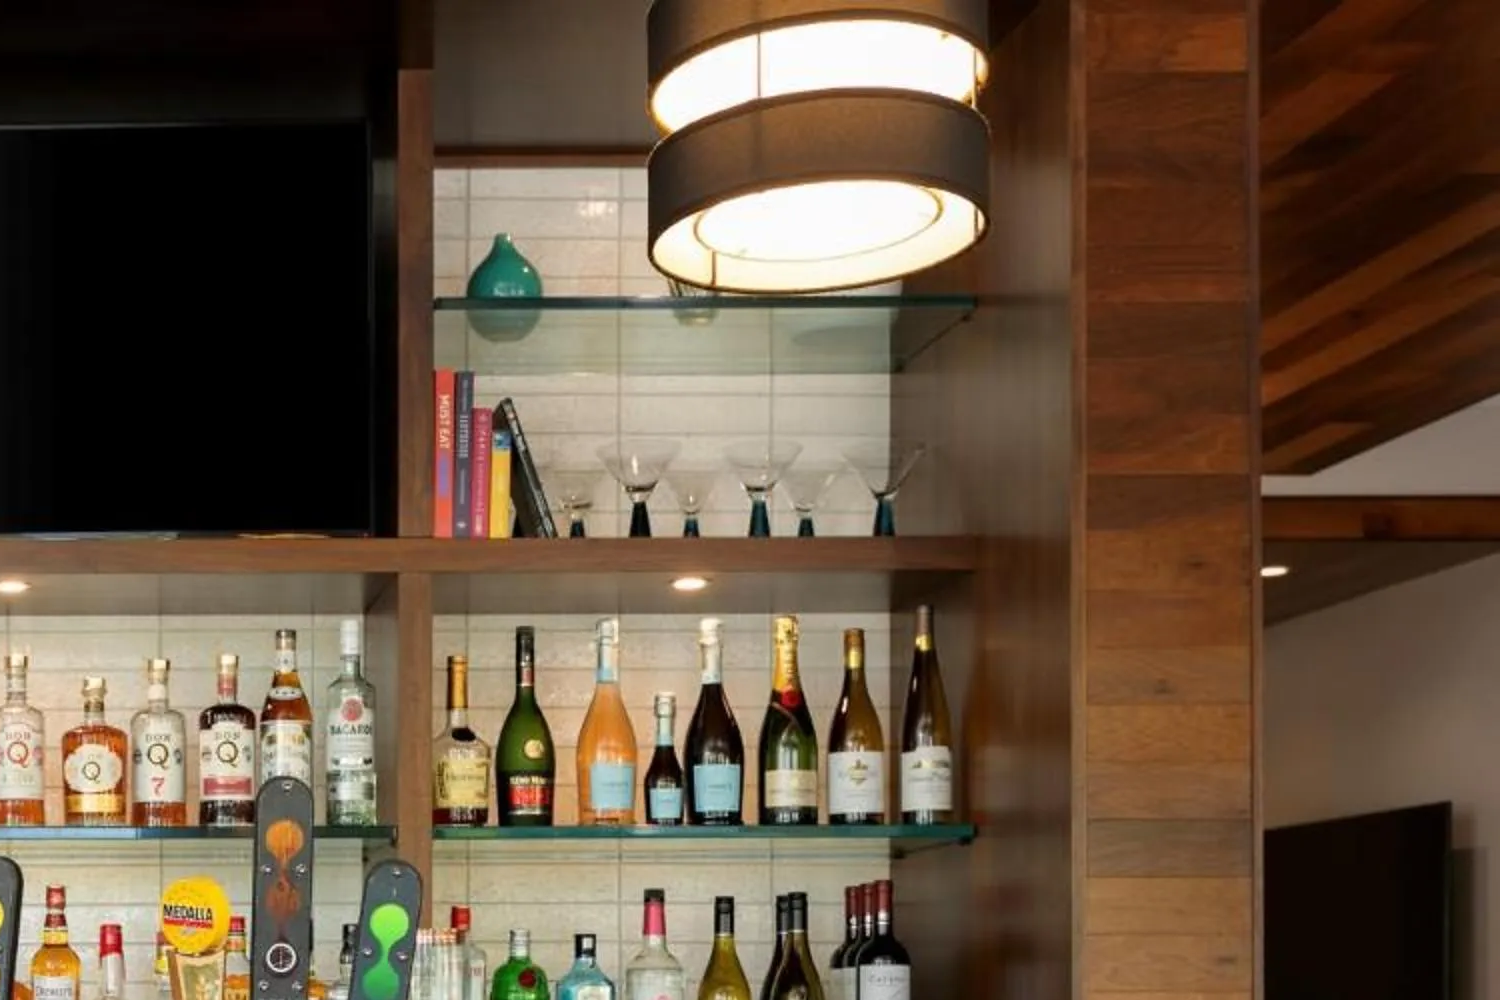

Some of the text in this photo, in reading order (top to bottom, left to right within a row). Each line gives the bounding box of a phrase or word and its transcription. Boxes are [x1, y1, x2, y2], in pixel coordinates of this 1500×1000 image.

[439, 394, 451, 449] MUST EAT
[7, 741, 29, 769] Q
[147, 742, 169, 770] Q
[216, 740, 239, 768] Q
[83, 761, 101, 784] Q
[150, 776, 165, 795] 7
[163, 903, 213, 921] MEDALLA
